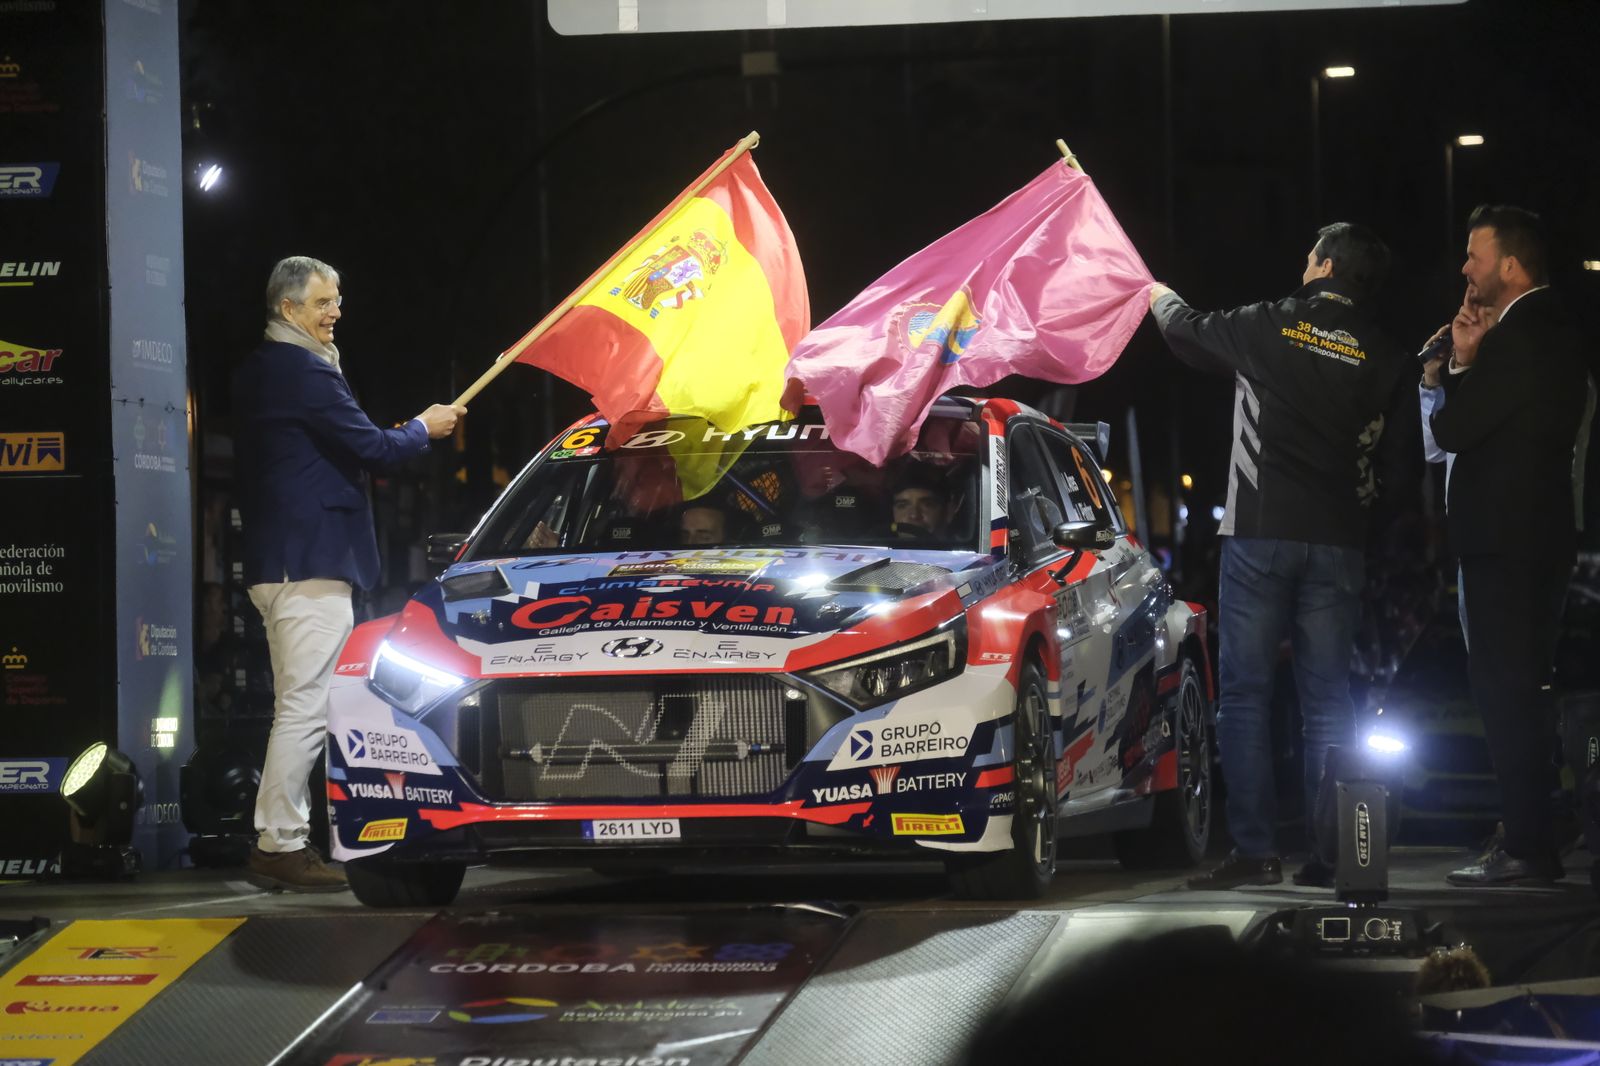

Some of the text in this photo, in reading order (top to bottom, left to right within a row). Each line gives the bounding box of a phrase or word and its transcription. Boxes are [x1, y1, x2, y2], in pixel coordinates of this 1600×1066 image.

[0, 261, 61, 277] ELIN
[1296, 321, 1312, 334] 38
[1282, 328, 1318, 345] SIERRA
[1320, 339, 1366, 360] MORENA
[0, 377, 64, 386] allycar.es
[562, 428, 601, 449] 6
[0, 543, 65, 559] ederación
[0, 561, 53, 576] ñola de
[511, 595, 795, 630] Caisven
[538, 618, 788, 636] Gallega de Aislamiento y Ventilación
[490, 652, 590, 665] ENAIRGY
[673, 648, 777, 659] ENAIRGY
[881, 721, 942, 741] GRUPO
[366, 731, 408, 749] GRUPO
[881, 736, 969, 758] BARREIRO
[370, 747, 429, 766] BARREIRO
[348, 783, 454, 804] YUASA BATTERY
[812, 772, 967, 803] YUASA BATTERY
[362, 821, 405, 838] PIRELLI
[599, 822, 635, 836] 2611
[641, 822, 674, 836] LYD
[895, 817, 961, 832] PIRELLI
[1358, 810, 1368, 860] BEAM 230
[429, 961, 636, 973] CÓRDOBA
